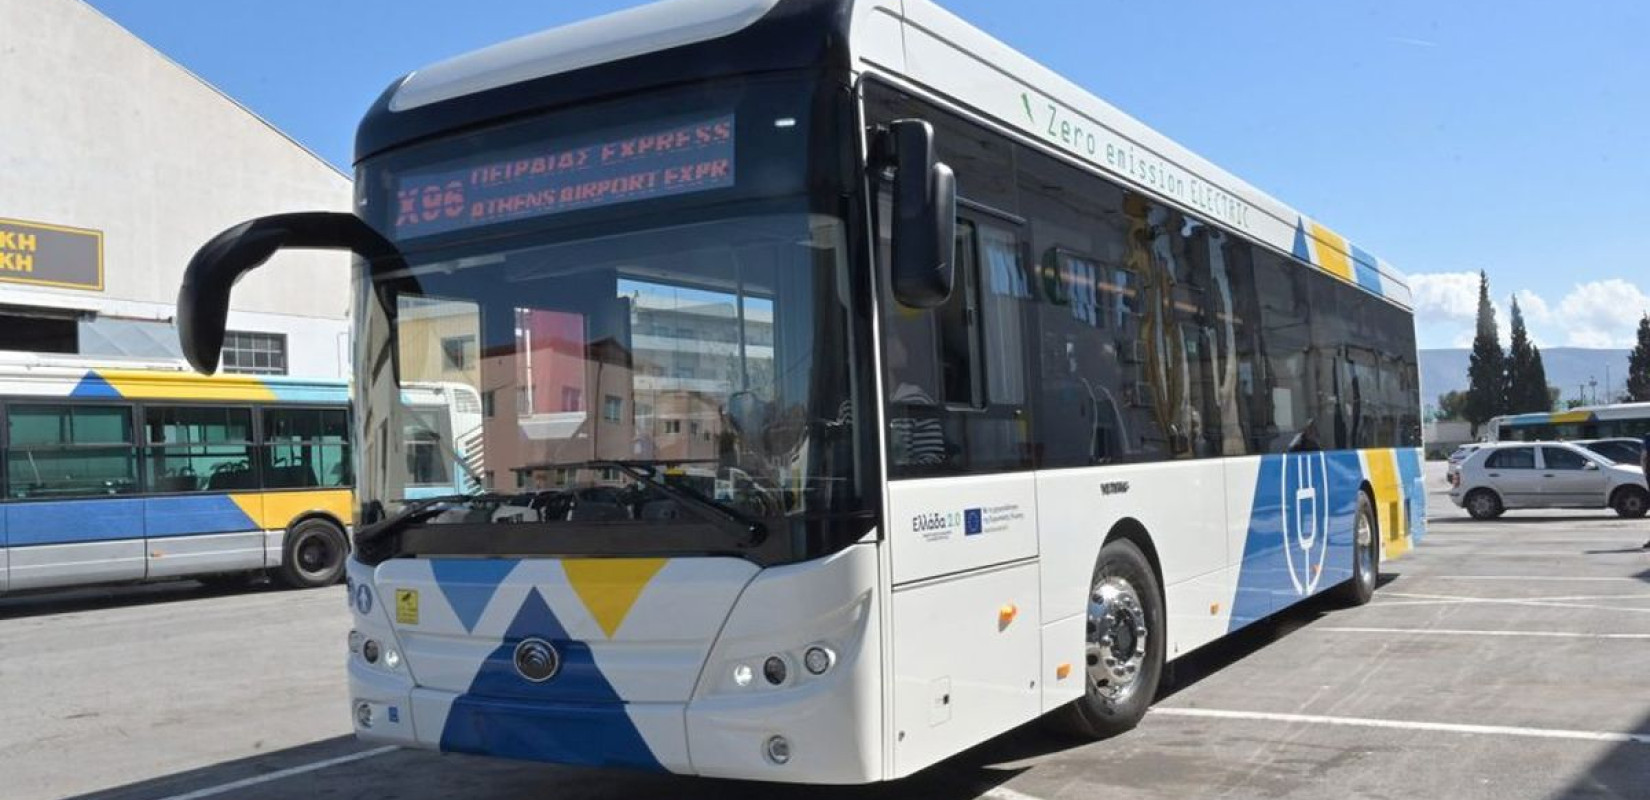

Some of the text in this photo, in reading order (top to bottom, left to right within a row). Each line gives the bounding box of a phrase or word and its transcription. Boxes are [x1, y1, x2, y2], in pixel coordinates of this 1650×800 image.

[470, 159, 730, 219] ATHENS AIRPORT EXPR
[1047, 104, 1250, 229] Zero emission ELECTRIC
